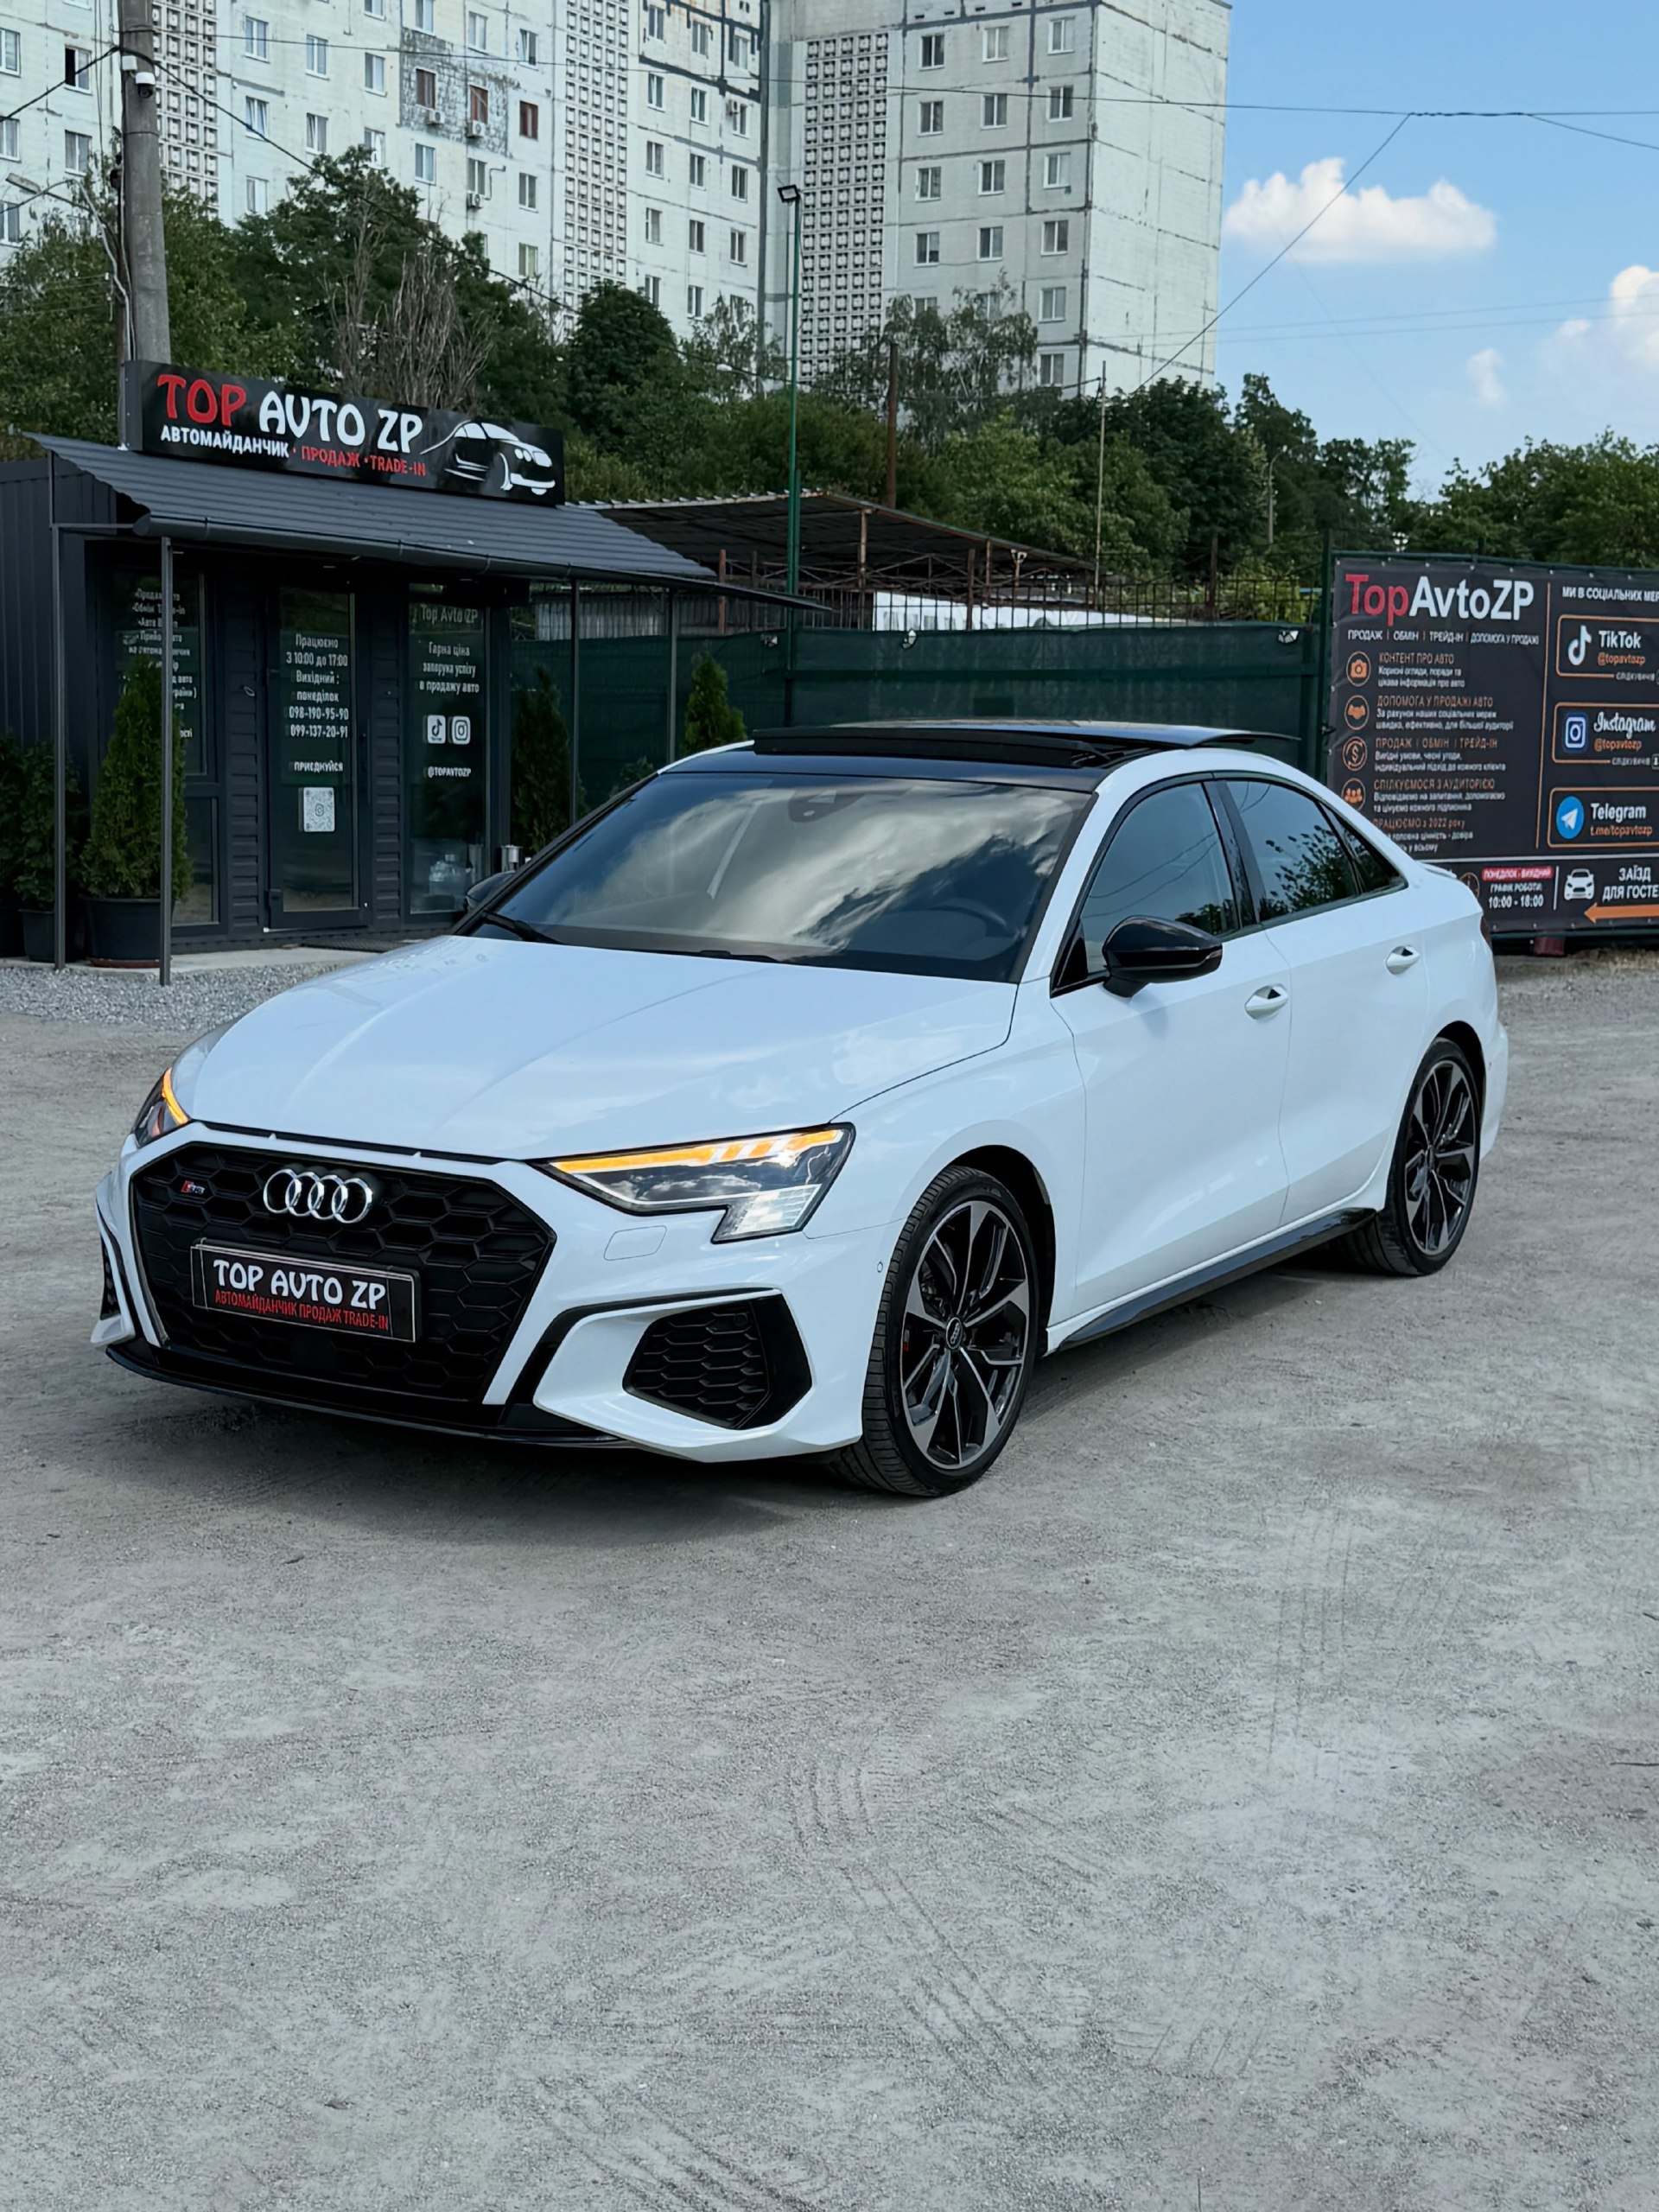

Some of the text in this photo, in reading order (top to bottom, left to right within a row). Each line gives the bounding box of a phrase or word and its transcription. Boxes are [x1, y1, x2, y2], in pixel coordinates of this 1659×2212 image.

[157, 374, 246, 426] TOP
[378, 409, 423, 454] ZP
[161, 425, 427, 478] АВТОМАЙДАНЧИК ПРОДАЖ TRADE-IN
[1345, 574, 1535, 626] TopAvtoZP
[1562, 587, 1577, 598] МИ
[1578, 587, 1586, 599] В
[420, 603, 439, 625] Top
[1348, 629, 1383, 641] ПРОДАЖ
[1393, 631, 1420, 641] ОБМІН
[1599, 630, 1642, 649] TikTok
[429, 641, 471, 657] Гарна ціна
[294, 652, 315, 665] 10:00
[315, 656, 327, 668] до
[1379, 652, 1454, 664] КОНТЕНТ ПРО АВТО
[461, 683, 480, 693] авто
[1377, 695, 1424, 708] ДОПОМОГА
[289, 706, 349, 721] 098-190-95-90
[290, 724, 348, 739] 099-137-20-91
[1593, 710, 1656, 740] Instagram
[1376, 737, 1413, 750] ПРОДАЖ
[1421, 738, 1450, 749] ОБМІН
[1590, 802, 1647, 823] Telegram
[1618, 864, 1651, 882] ЗАЇЗД
[1489, 894, 1513, 910] 10:00
[1520, 893, 1545, 908] 18:00
[1602, 883, 1659, 904] ДЛЯ ГОСТЕ
[213, 1259, 264, 1292] TOP
[351, 1281, 386, 1310] ZP
[215, 1288, 389, 1332] АВТОМАЙДАНЧИК ПРОДАЖ TRADE-IN
